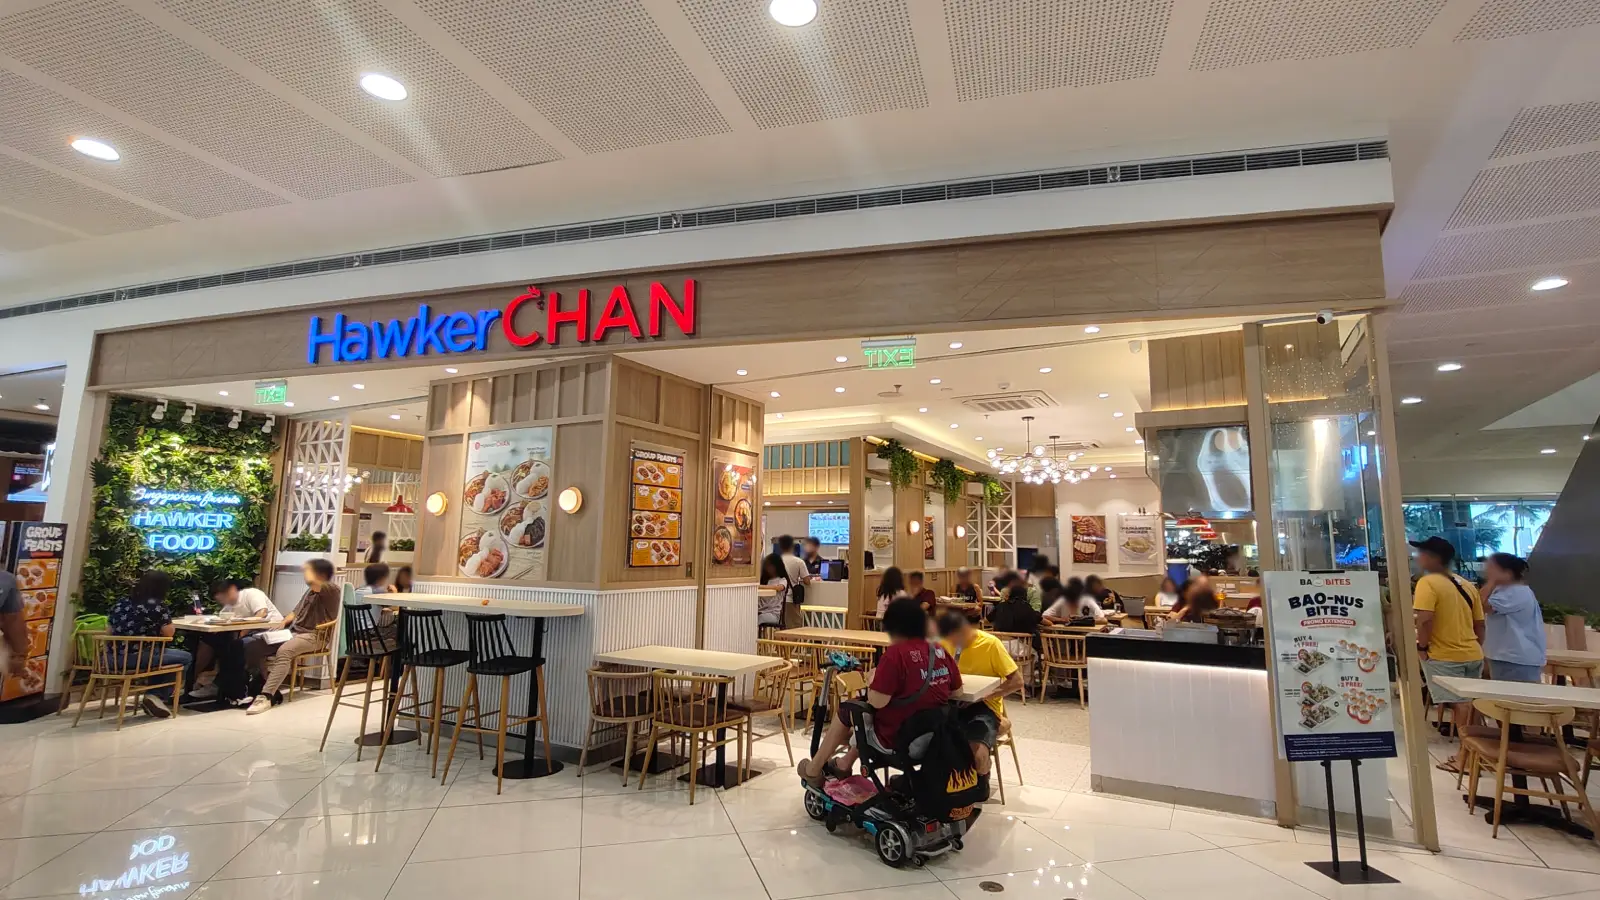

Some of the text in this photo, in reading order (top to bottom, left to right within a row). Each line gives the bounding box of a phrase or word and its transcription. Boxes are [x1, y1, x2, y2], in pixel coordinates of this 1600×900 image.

[307, 280, 696, 363] Hawker CHAN
[134, 511, 233, 528] HAWKER
[26, 526, 62, 538] GROUP
[24, 538, 63, 551] FEASTS
[148, 534, 215, 550] FOOD
[1288, 592, 1364, 609] BAO-NUS
[1306, 606, 1348, 617] BITES
